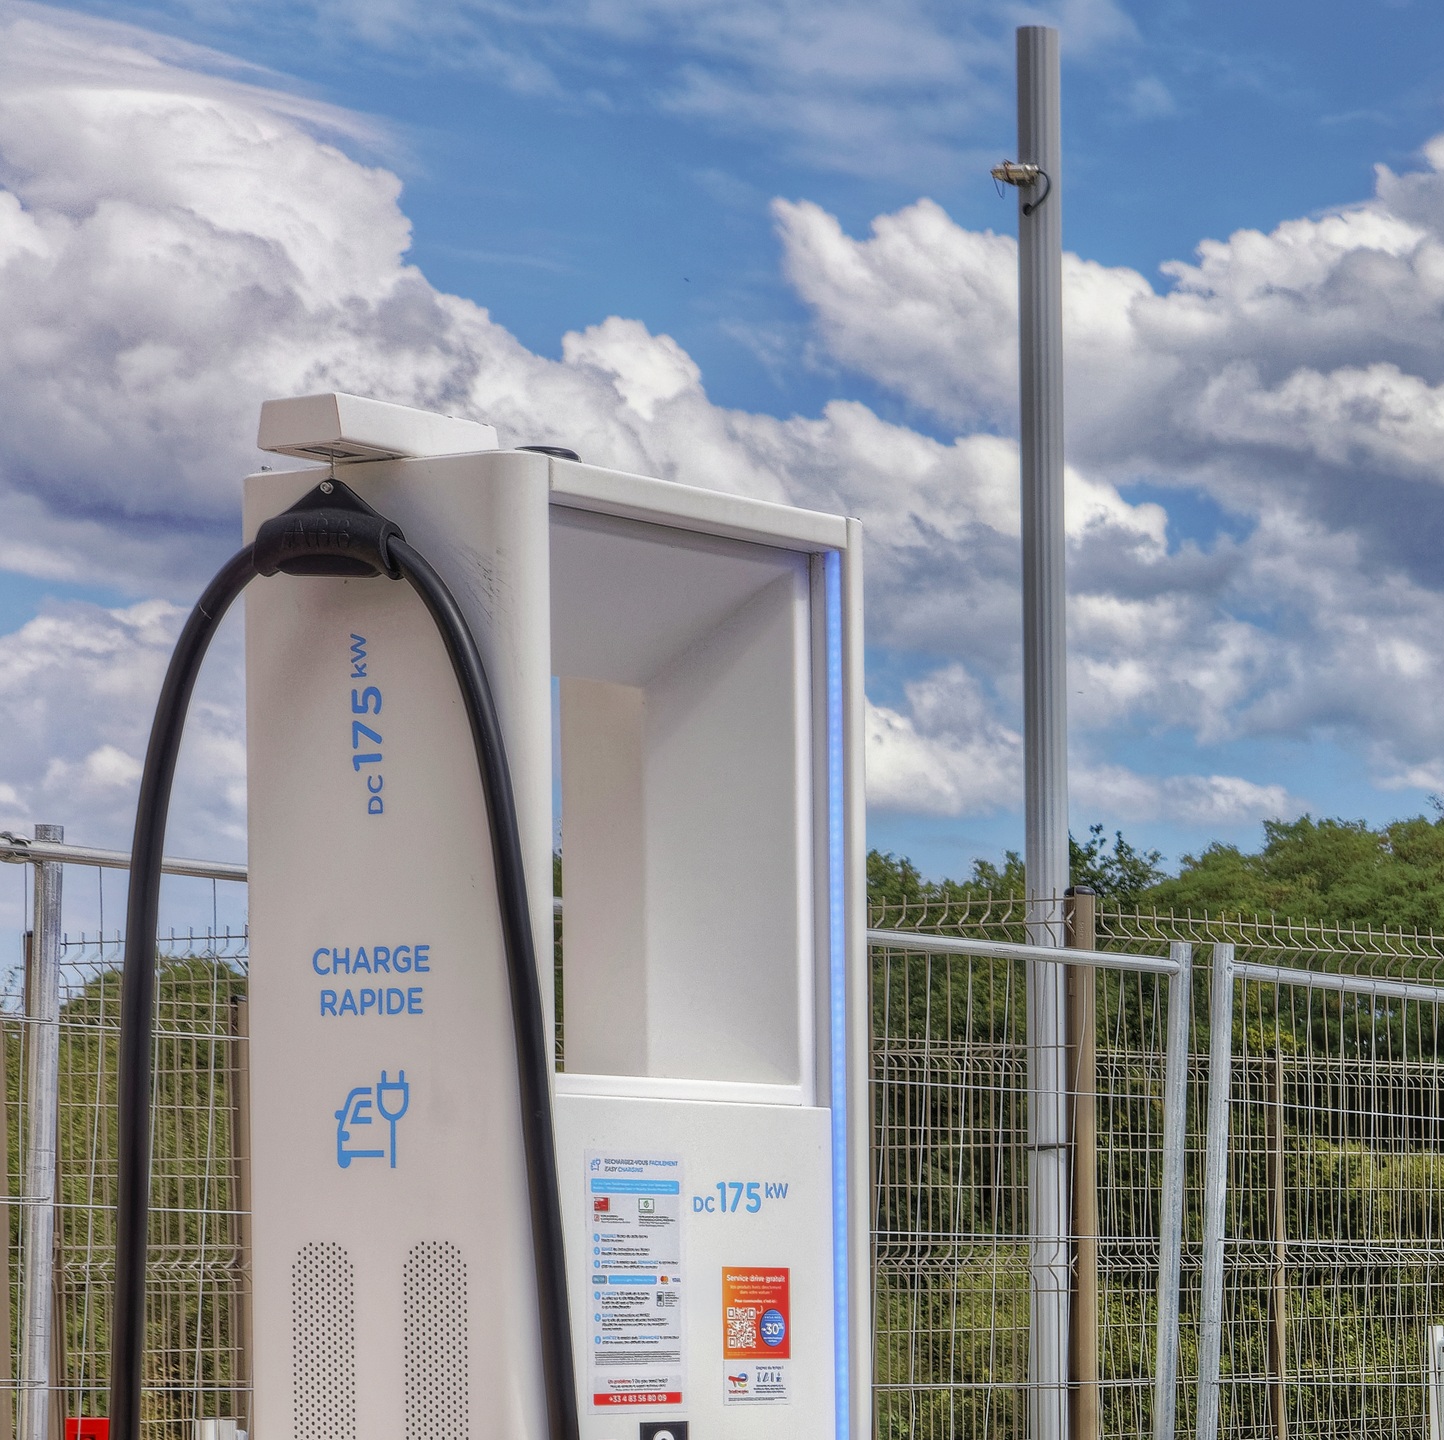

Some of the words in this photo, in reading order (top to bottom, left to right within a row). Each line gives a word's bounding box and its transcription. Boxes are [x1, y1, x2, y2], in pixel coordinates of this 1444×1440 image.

[312, 944, 431, 976] CHARGE
[319, 986, 424, 1017] RAPIDE
[727, 1274, 749, 1282] Service
